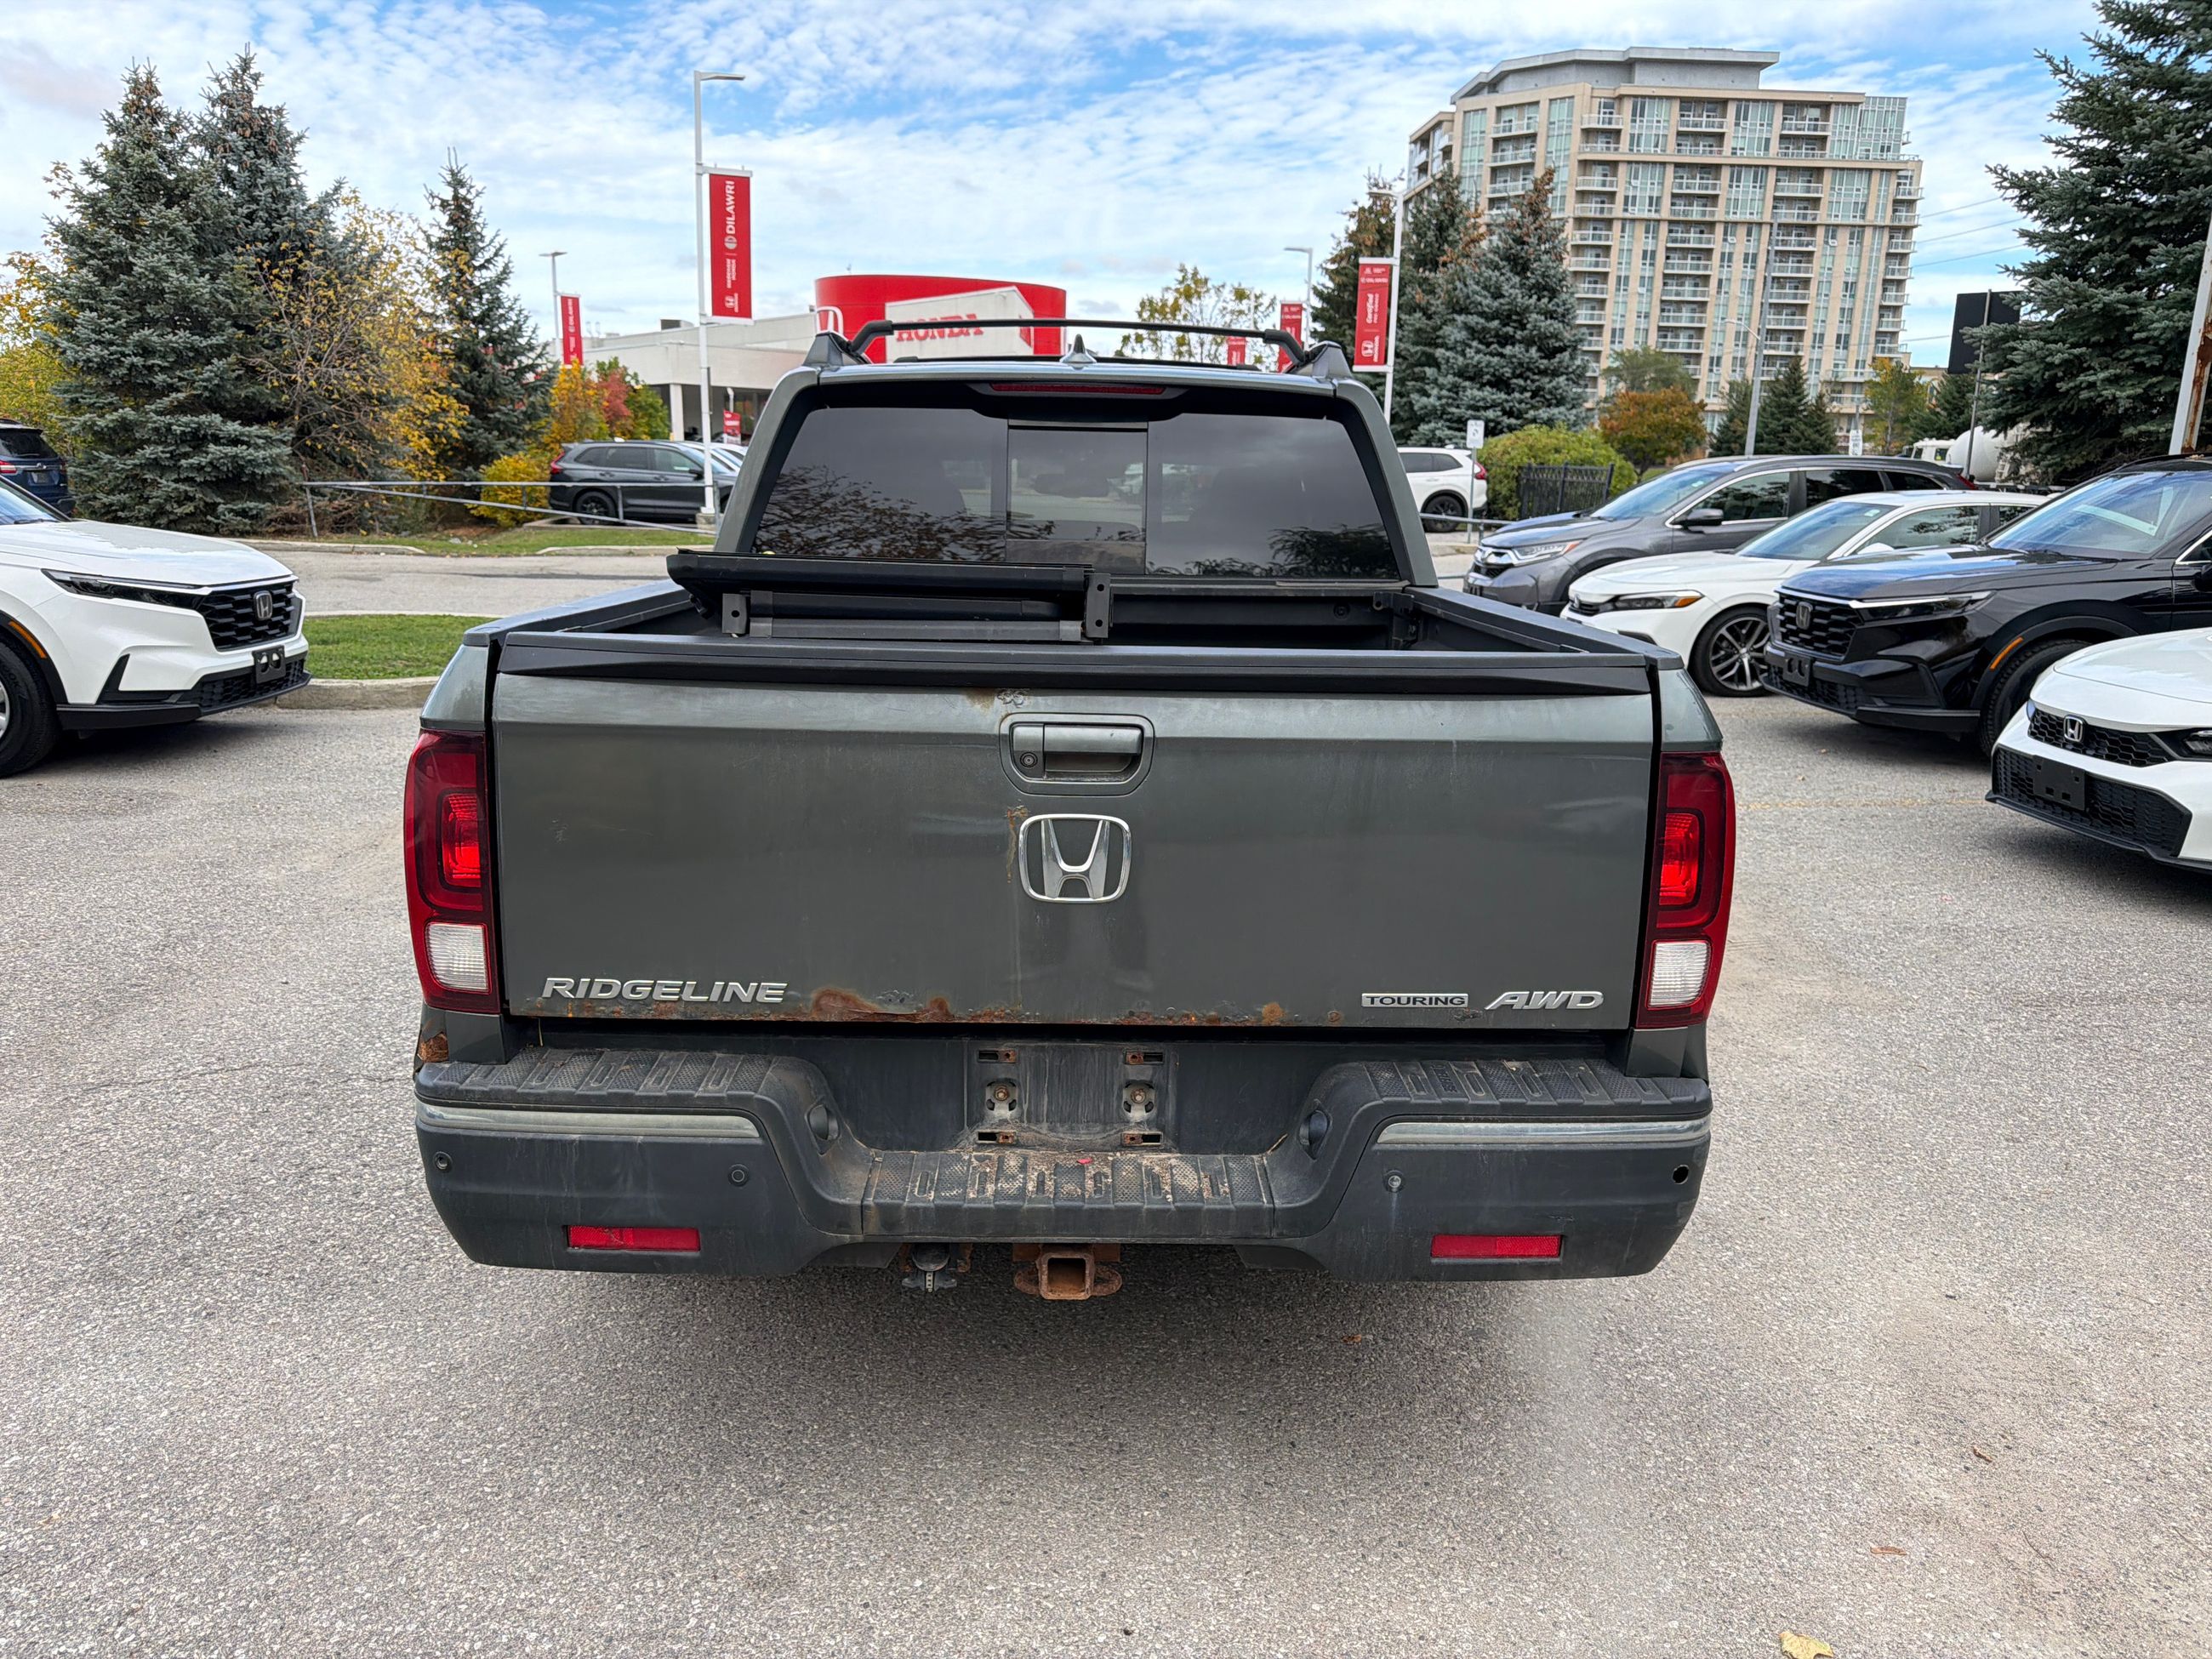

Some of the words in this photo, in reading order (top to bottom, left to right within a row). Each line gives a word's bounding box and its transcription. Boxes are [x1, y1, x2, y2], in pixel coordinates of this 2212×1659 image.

[725, 180, 736, 234] DILAWRI
[897, 313, 984, 342] HONDA
[541, 977, 789, 1003] RIDGELINE
[1364, 995, 1467, 1007] TOURING
[1484, 990, 1605, 1011] AWD
